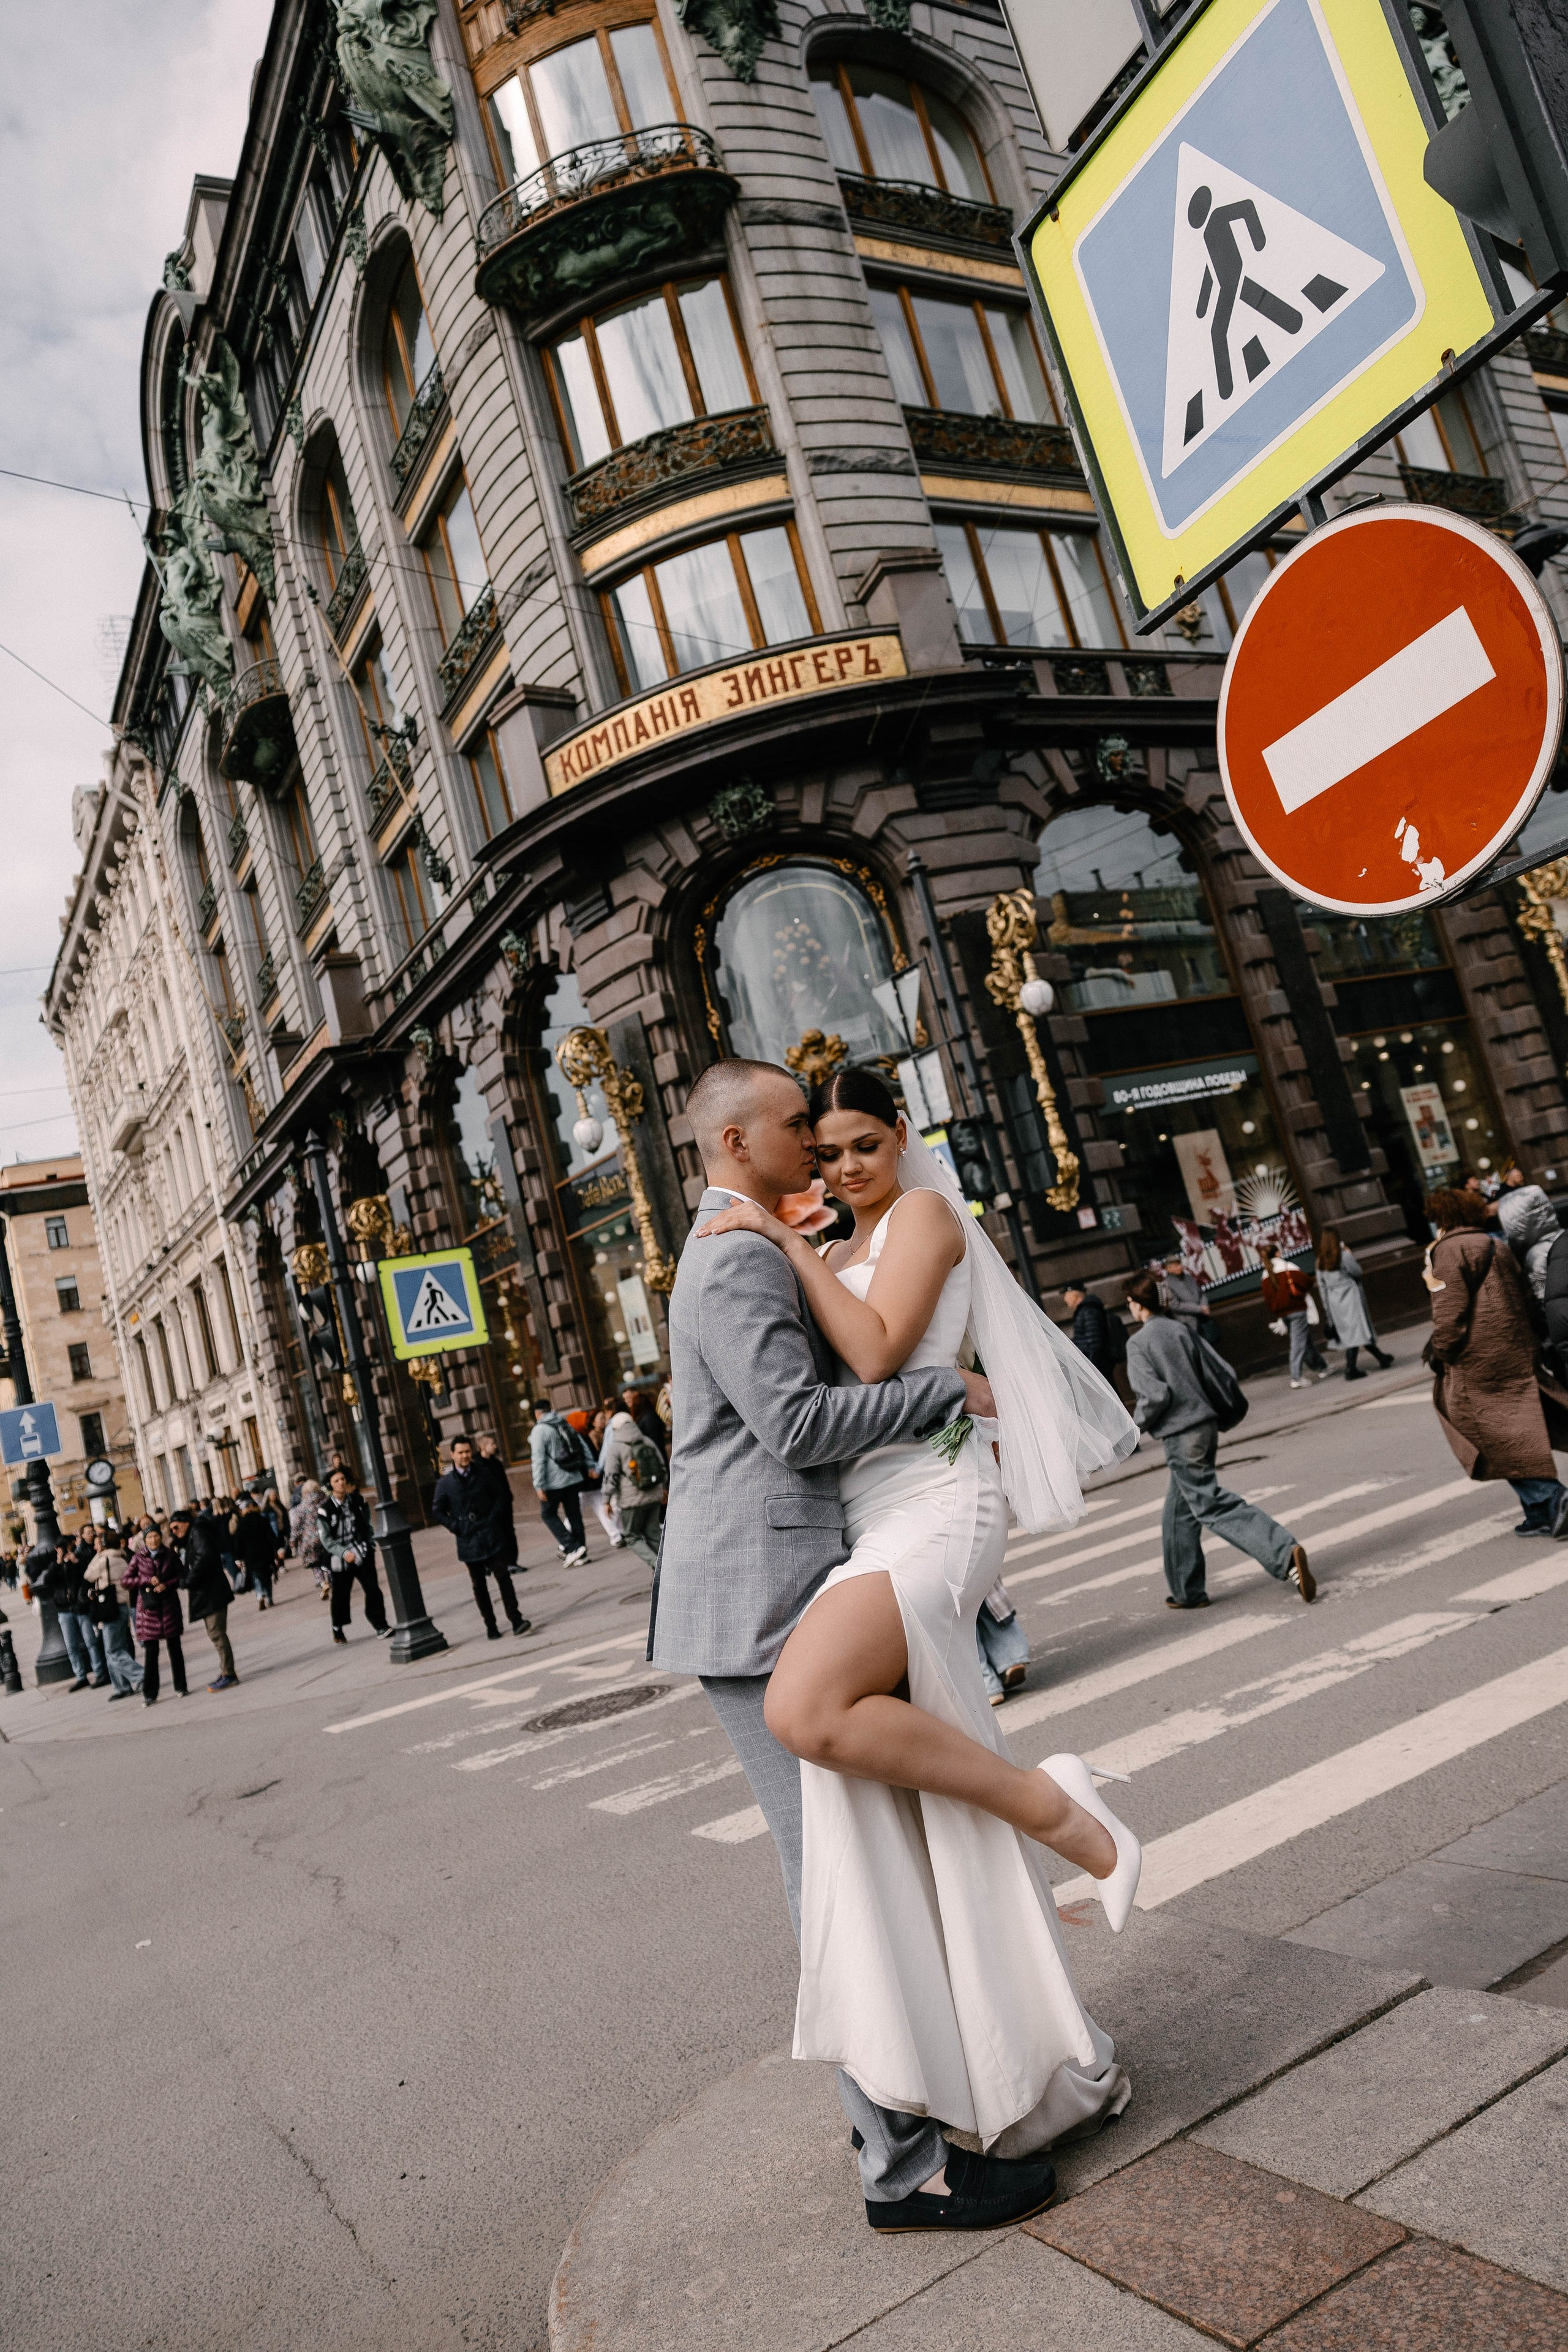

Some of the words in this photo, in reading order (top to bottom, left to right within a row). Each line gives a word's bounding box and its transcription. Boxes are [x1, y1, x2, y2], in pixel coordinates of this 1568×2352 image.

[560, 688, 701, 783] КОМПАНІЯ
[722, 644, 881, 708] ЗИНГЕРЪ
[1140, 1076, 1207, 1099] ГОДОВЩИНА
[1204, 1069, 1247, 1087] ПОБЕДЫ
